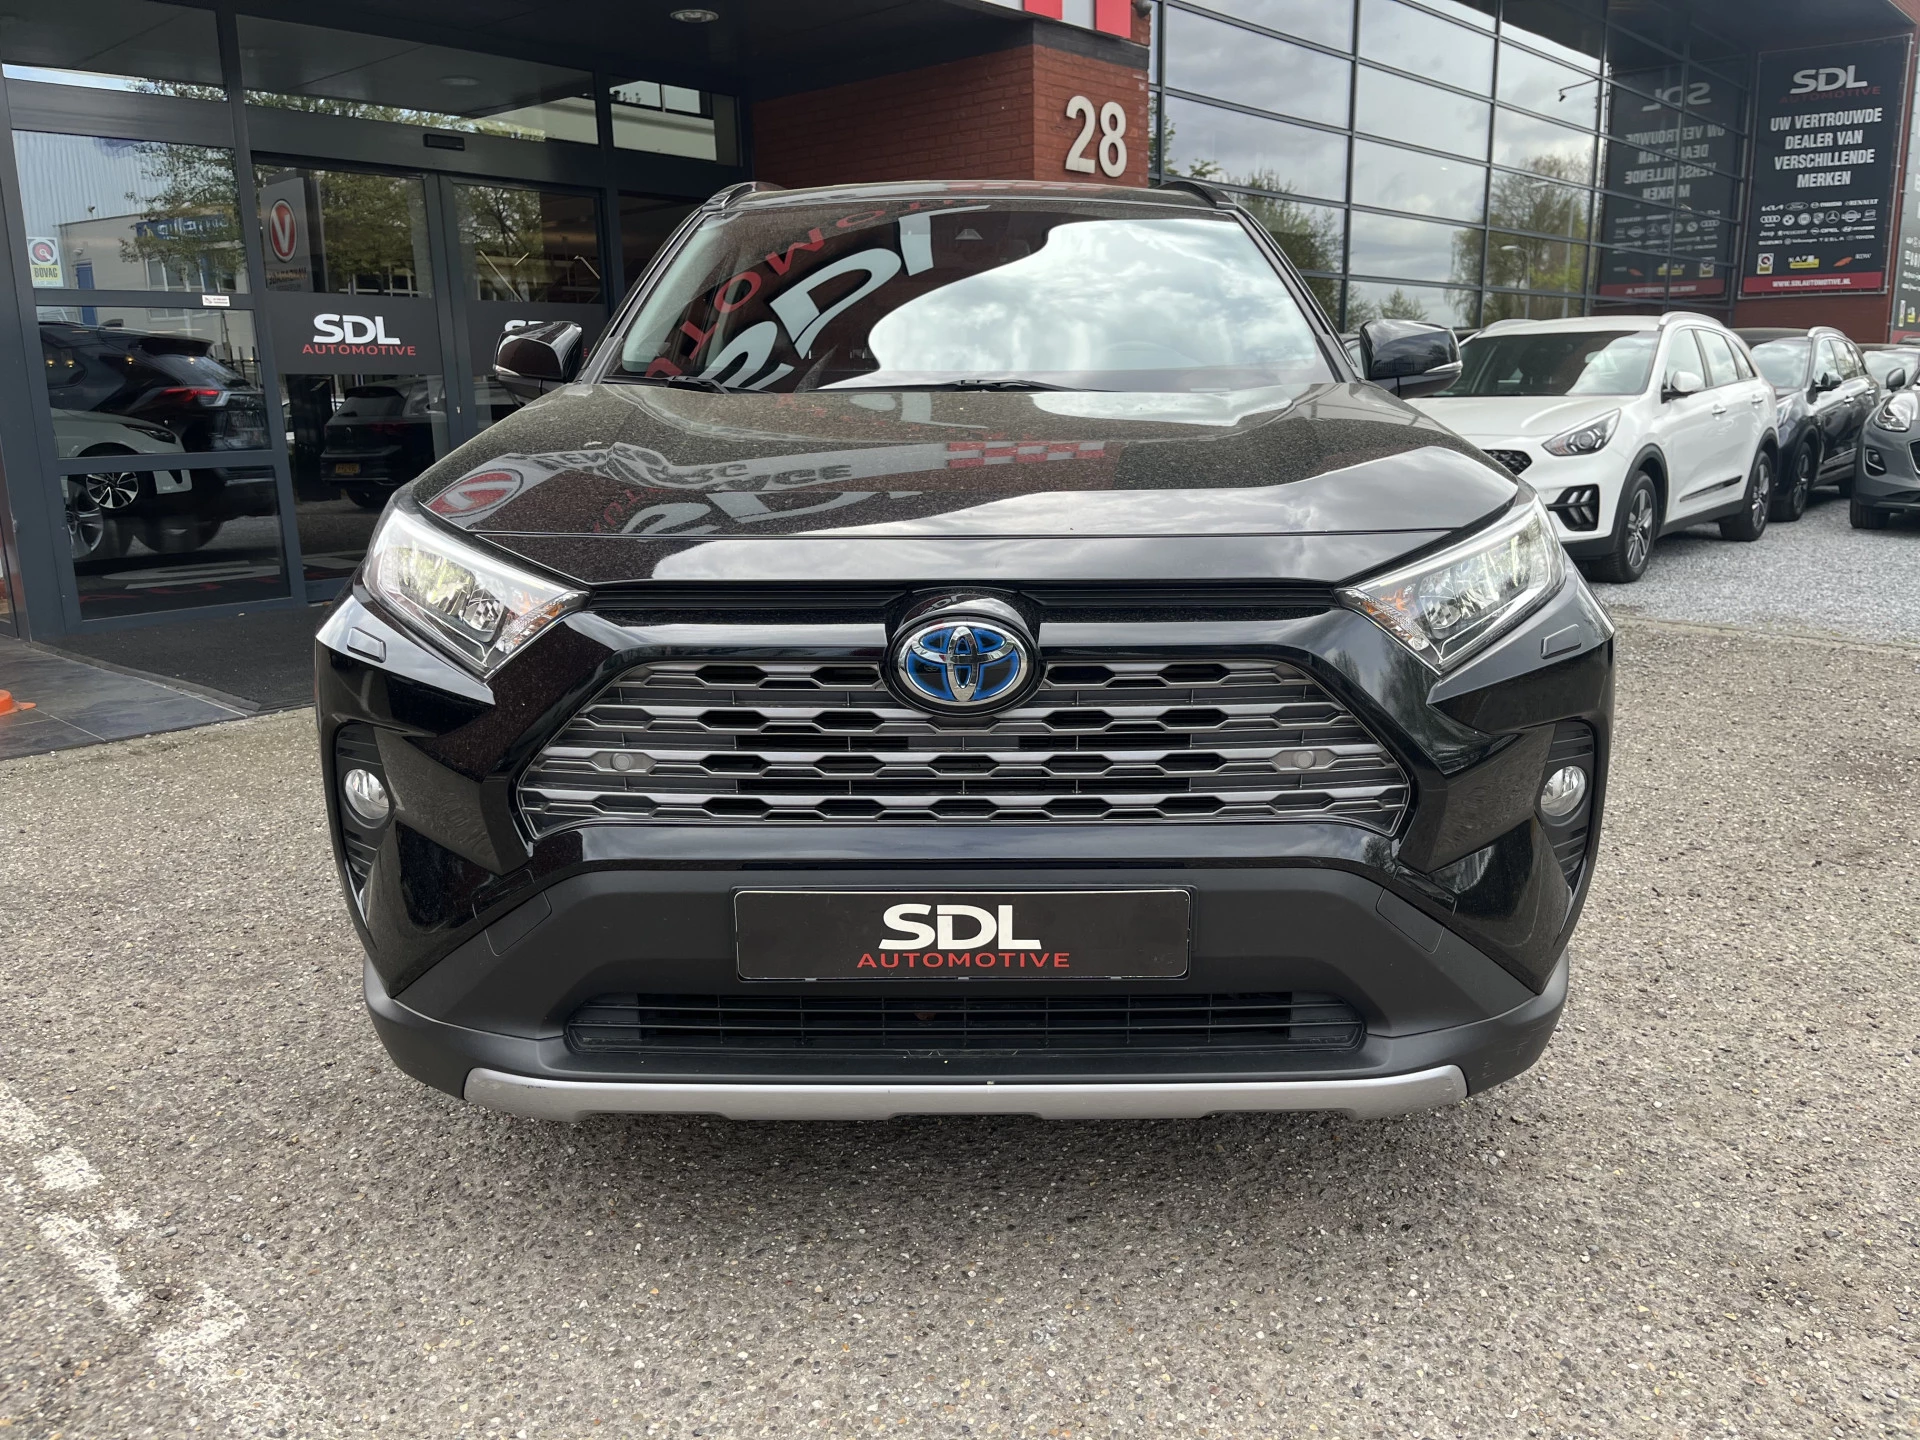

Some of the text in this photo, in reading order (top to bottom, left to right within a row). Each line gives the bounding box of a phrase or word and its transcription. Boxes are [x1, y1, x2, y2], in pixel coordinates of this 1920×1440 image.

[1790, 65, 1868, 94] SDL
[1779, 86, 1881, 103] AUTOMOTIVE
[1770, 107, 1882, 131] UW VERTROUWDE
[1065, 95, 1127, 177] 28
[1785, 130, 1863, 150] DEALER VAN
[1774, 149, 1875, 170] VERSCHILLENDE
[1797, 171, 1851, 188] MERKEN
[313, 313, 401, 345] SDL
[302, 344, 416, 356] AUTOMOTIVE
[878, 903, 1042, 950] SDL
[857, 953, 1070, 968] AUTOMOTIVE
